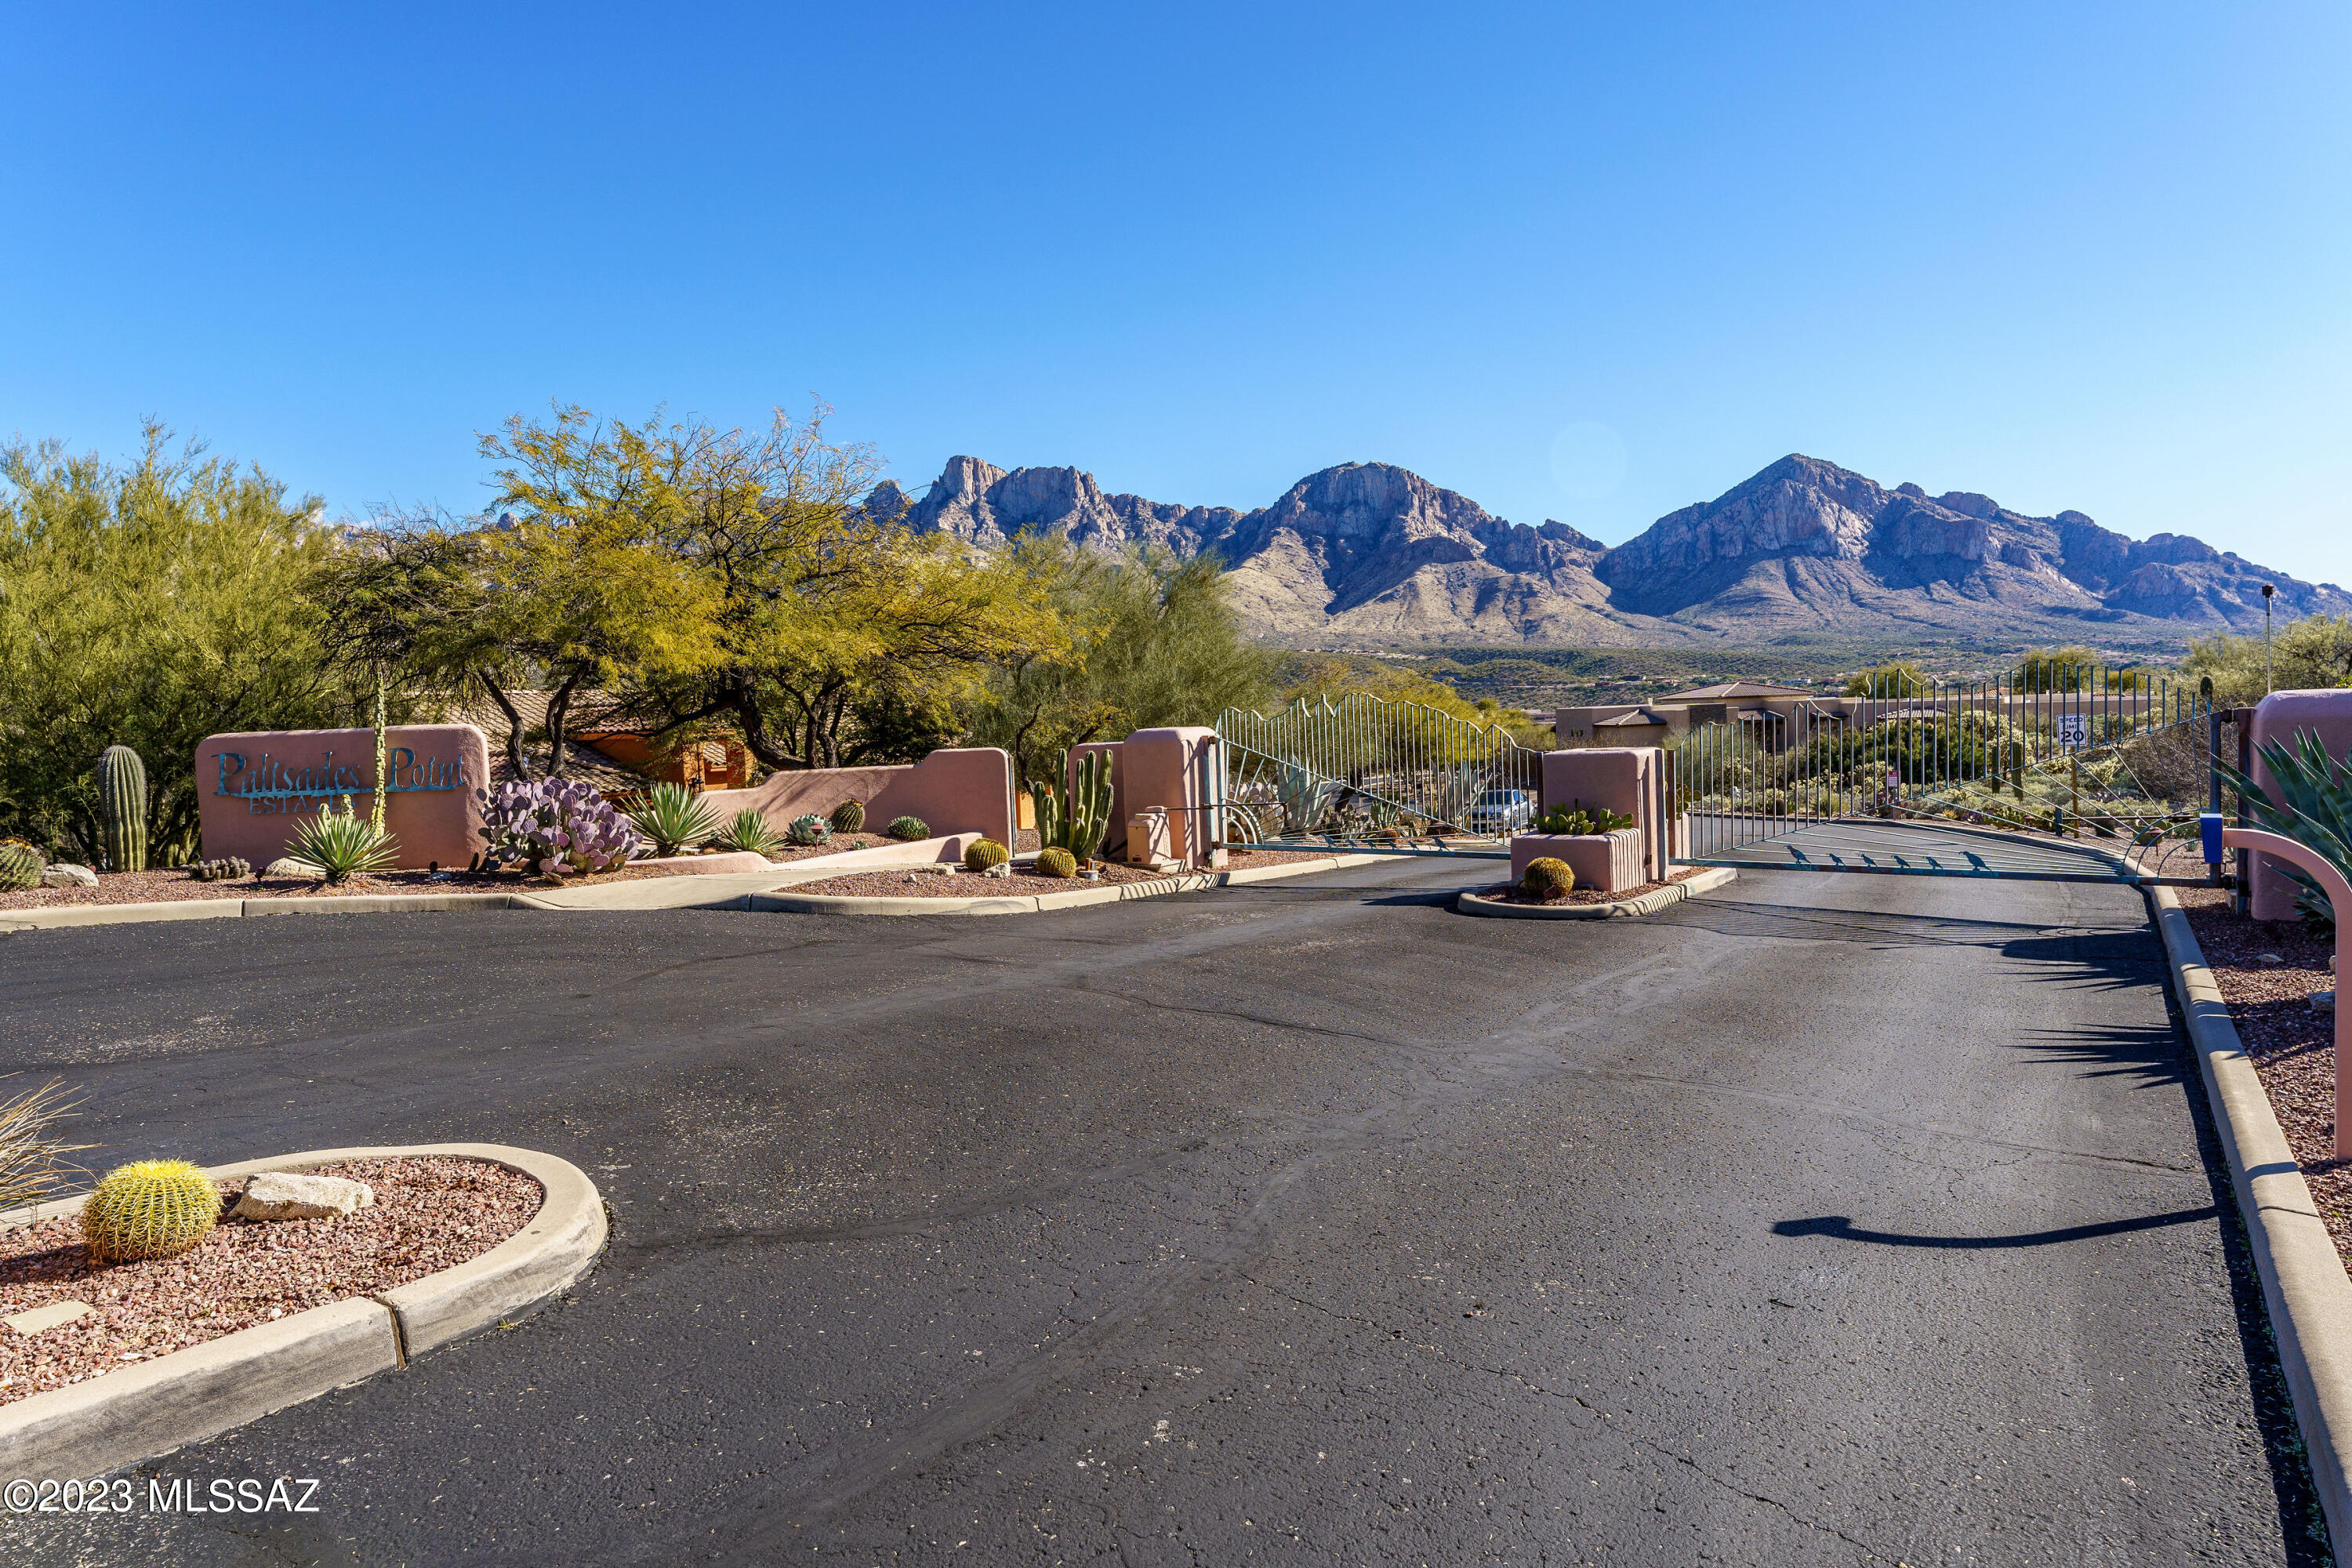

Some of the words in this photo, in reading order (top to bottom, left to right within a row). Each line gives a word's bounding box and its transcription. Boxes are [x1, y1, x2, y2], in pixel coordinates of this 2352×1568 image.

[2060, 731, 2084, 742] 20
[212, 750, 360, 795] Palisades
[385, 747, 468, 789] Point
[249, 794, 357, 814] ESTATE
